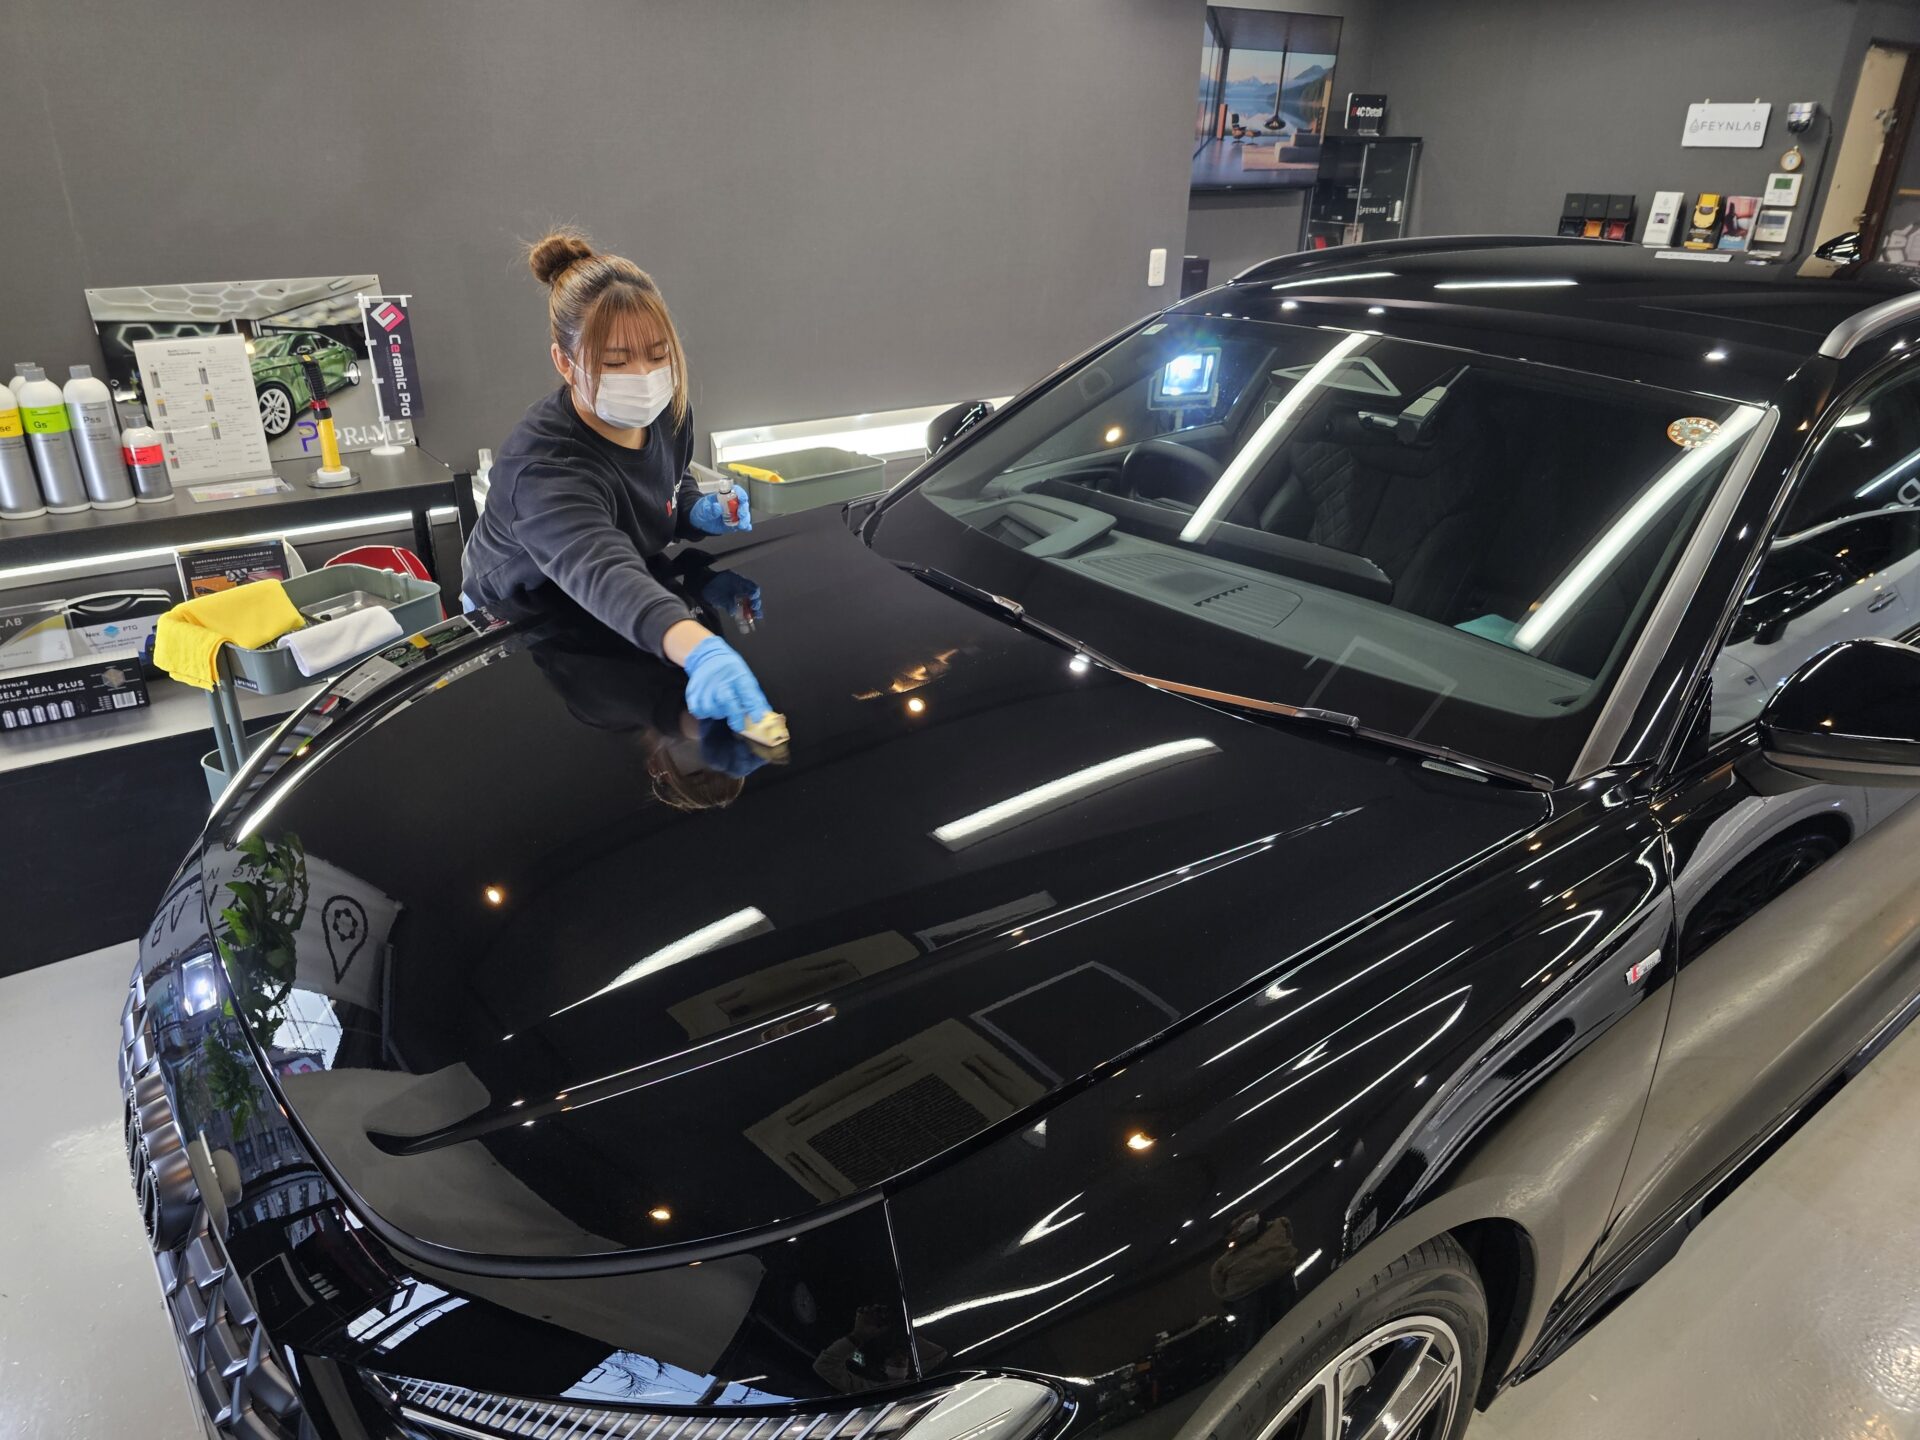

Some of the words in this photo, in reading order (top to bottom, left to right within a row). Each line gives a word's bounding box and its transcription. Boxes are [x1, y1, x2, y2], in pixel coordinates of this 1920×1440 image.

[1700, 121, 1761, 131] FEYNLAB
[389, 334, 407, 390] Ceramic
[399, 392, 411, 417] Pro
[33, 421, 48, 429] Gs
[26, 685, 54, 695] HEAL
[57, 680, 84, 690] PLUS
